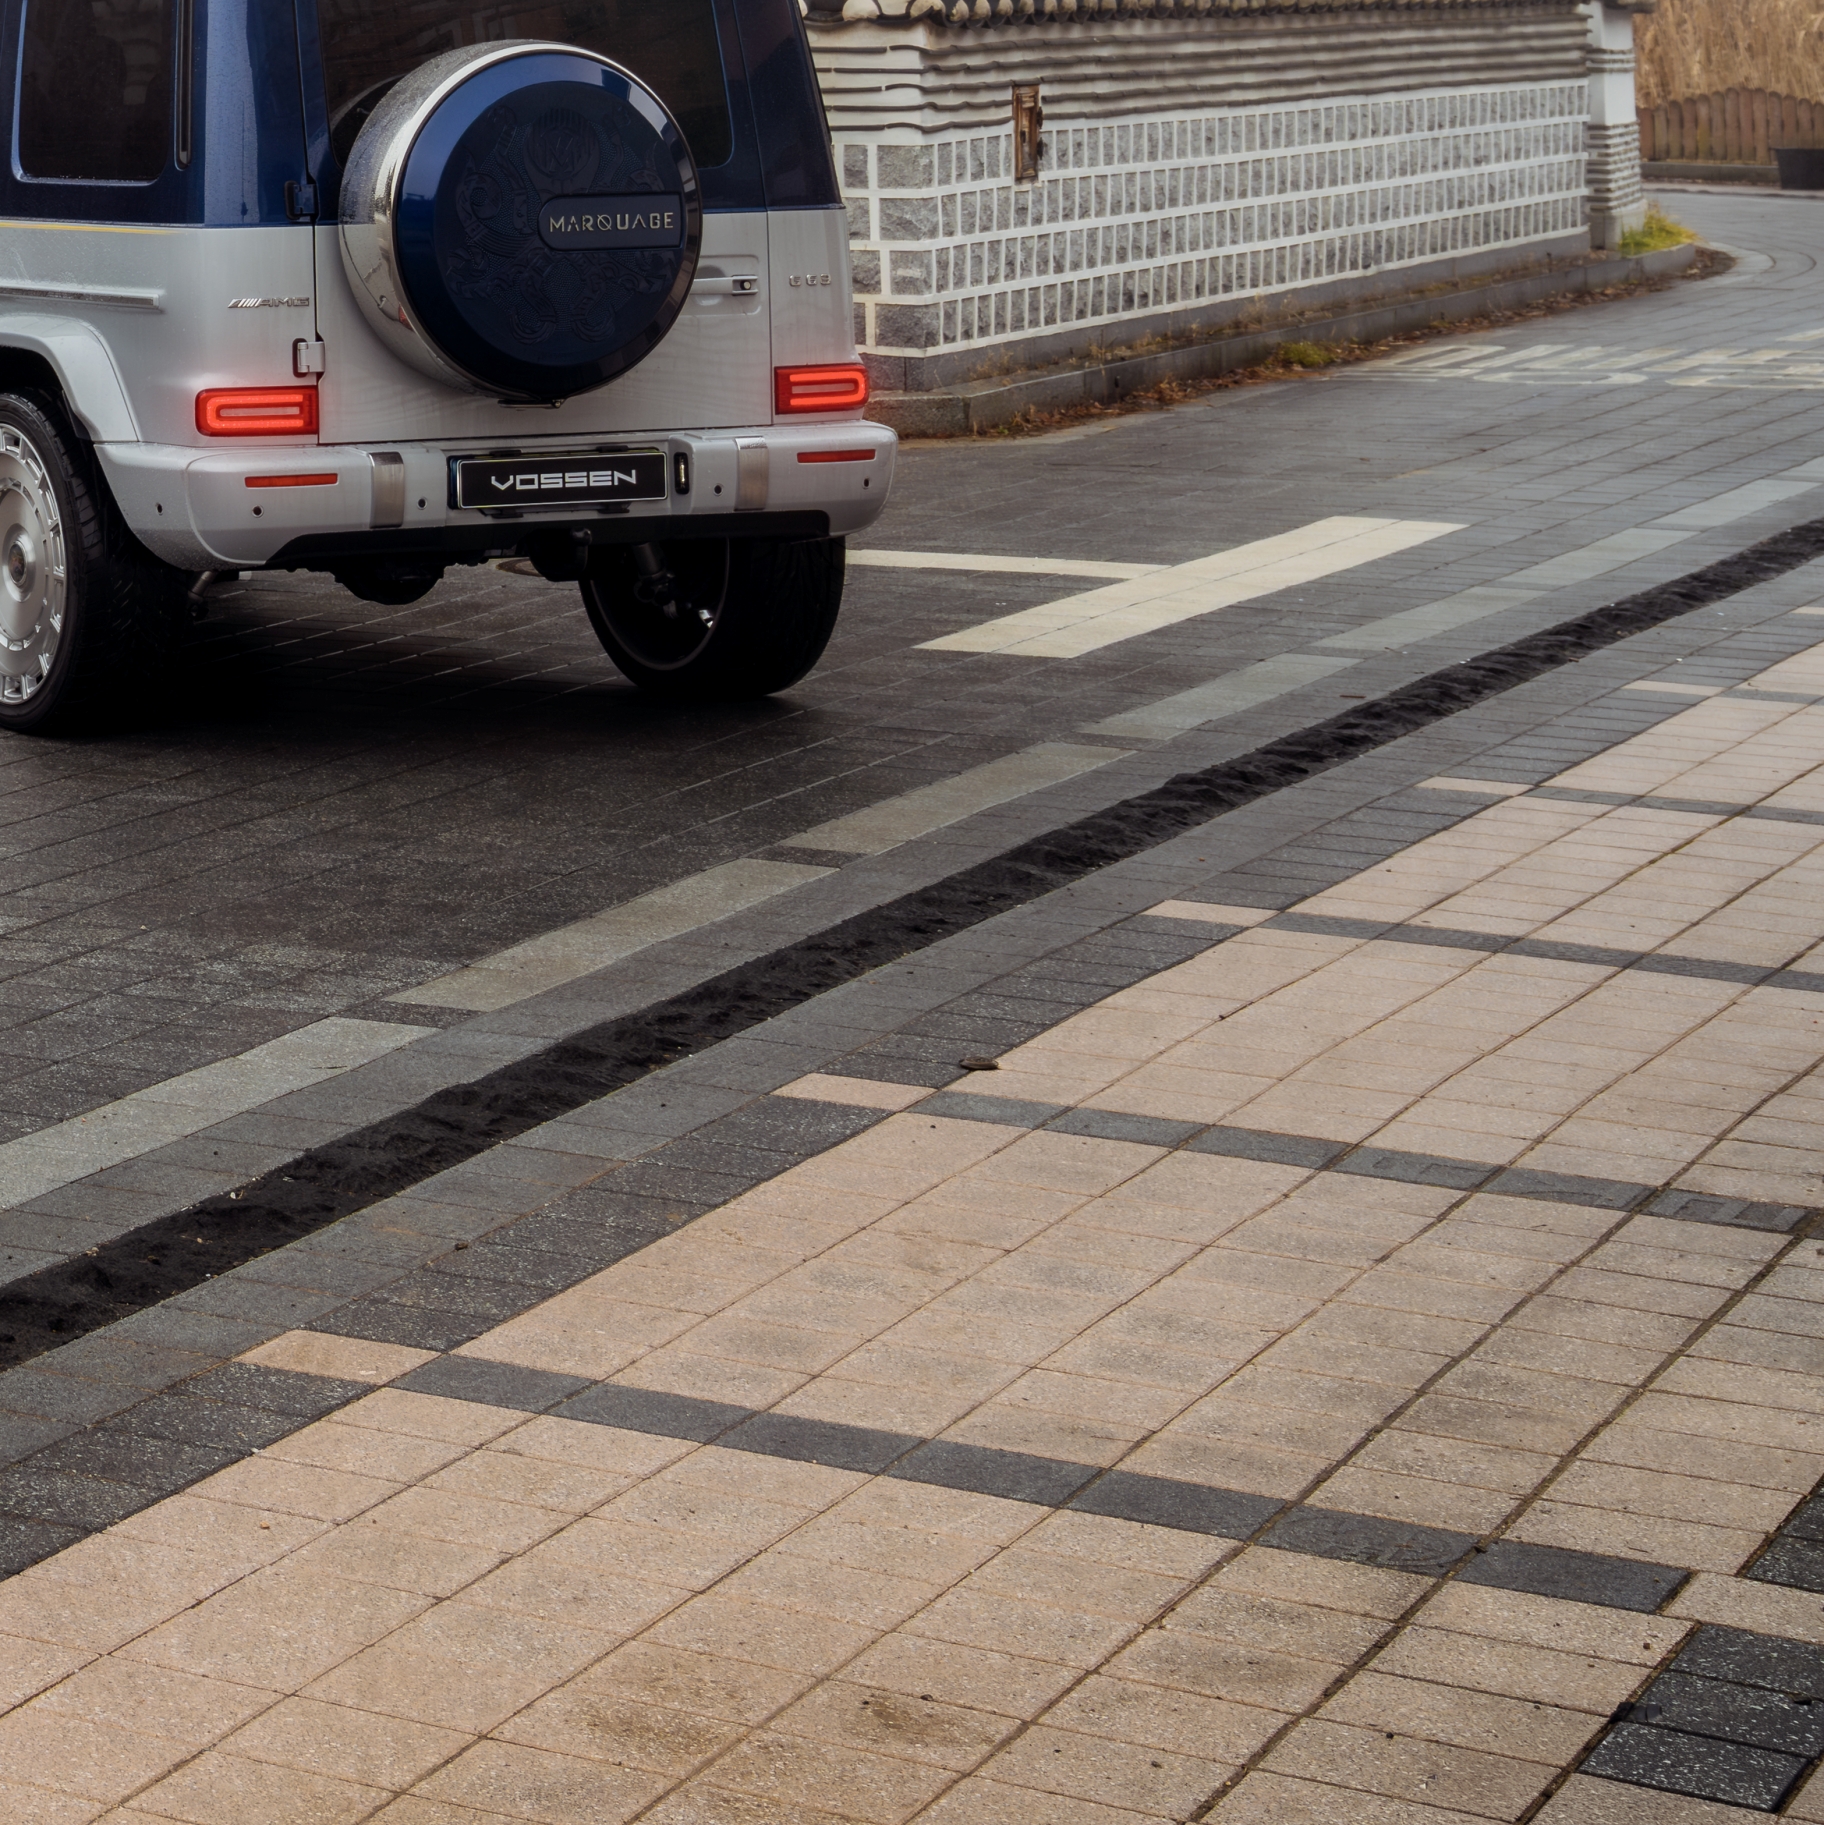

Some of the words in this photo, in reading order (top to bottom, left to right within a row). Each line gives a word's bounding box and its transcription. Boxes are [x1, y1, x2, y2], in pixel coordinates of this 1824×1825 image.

[549, 212, 674, 233] MARQUAGE
[255, 297, 310, 308] AMG
[491, 469, 637, 491] VOSSEN
